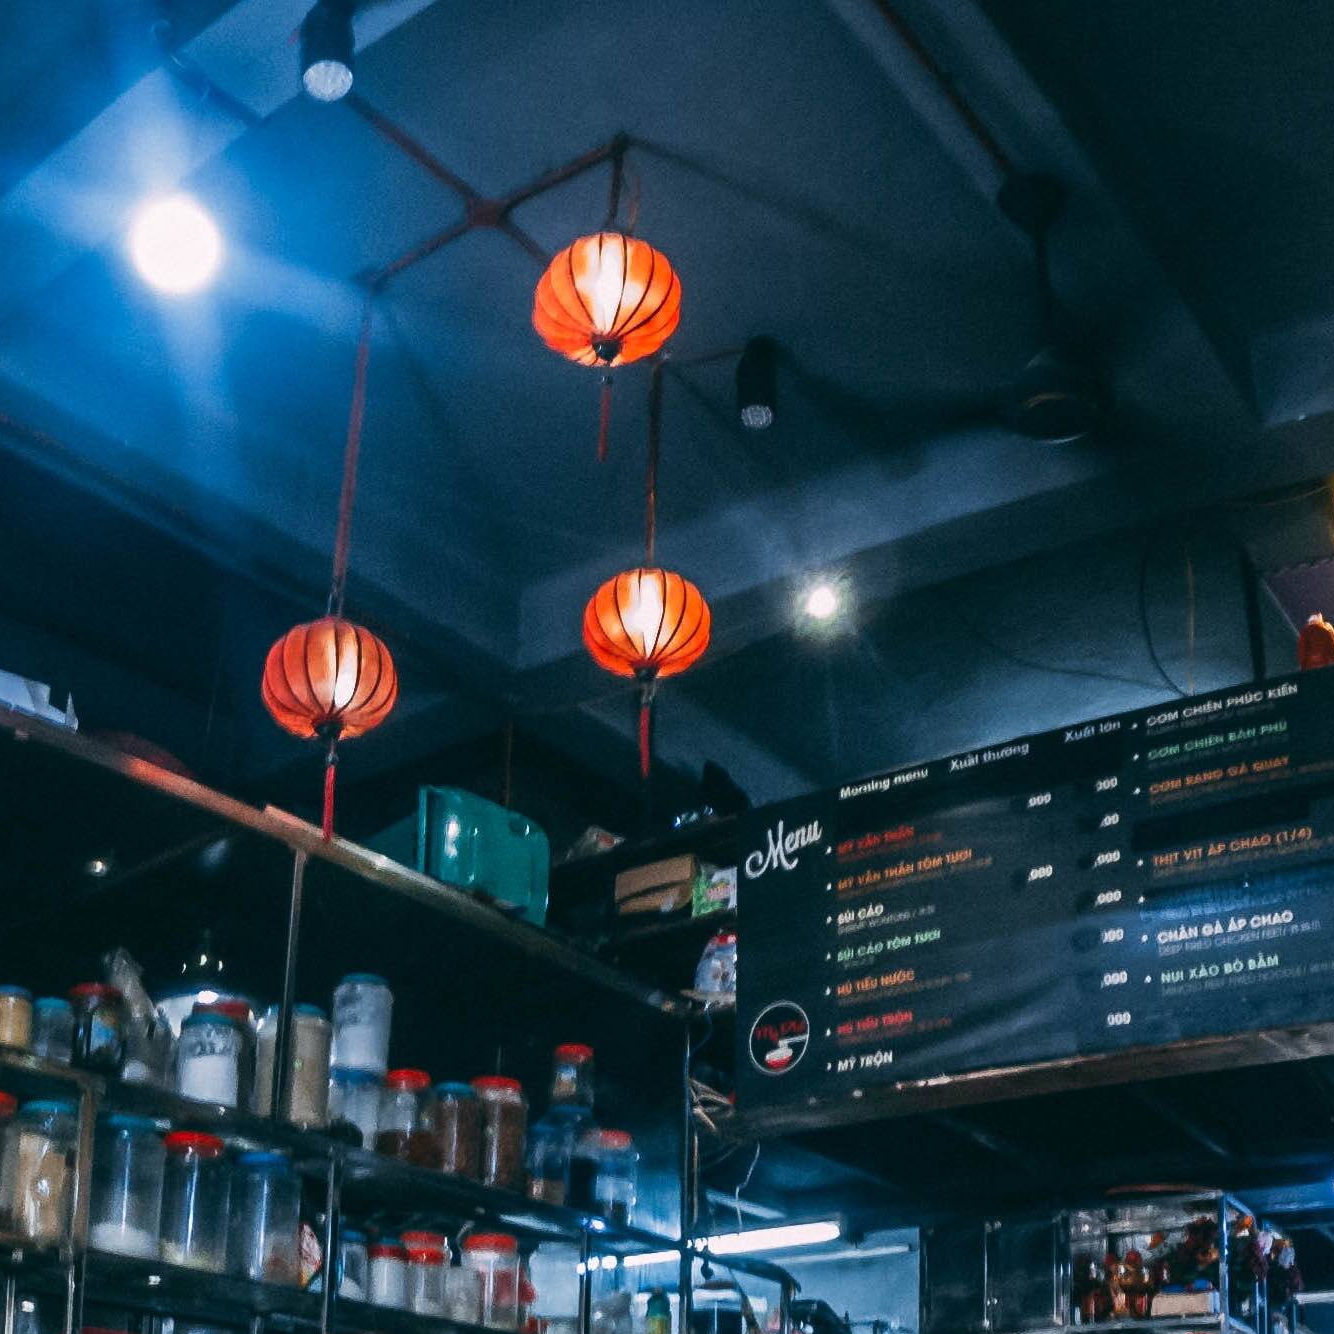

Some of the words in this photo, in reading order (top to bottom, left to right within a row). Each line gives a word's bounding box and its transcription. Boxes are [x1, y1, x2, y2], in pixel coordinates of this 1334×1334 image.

[839, 778, 890, 800] Morning
[894, 767, 929, 786] menu
[745, 819, 823, 879] Menu
